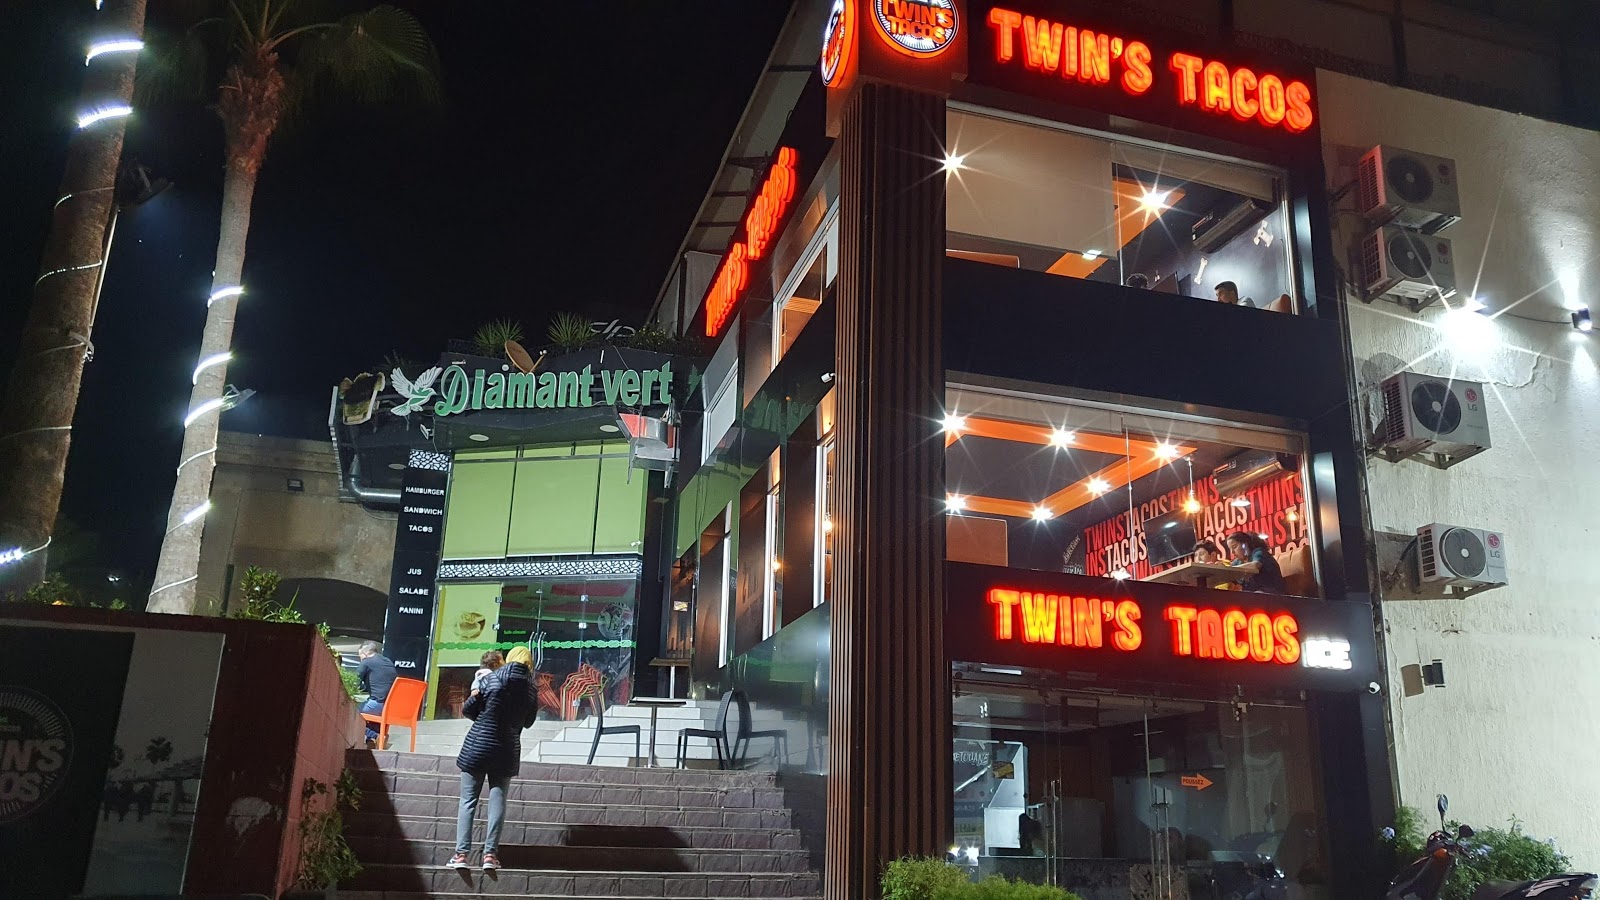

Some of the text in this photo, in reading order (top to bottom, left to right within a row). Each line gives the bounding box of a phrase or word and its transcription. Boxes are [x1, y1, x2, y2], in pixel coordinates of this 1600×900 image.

[886, 15, 946, 45] TACOS
[987, 7, 1314, 133] TWIN'S TACOS
[434, 360, 674, 416] Diamant vert
[1467, 404, 1478, 412] LG
[405, 486, 445, 496] HAMBURGER
[403, 506, 443, 516] SANDWICH
[408, 524, 433, 533] TACOS
[1489, 550, 1501, 559] LG
[407, 568, 422, 576] JUS
[399, 606, 424, 615] PANINI
[989, 588, 1142, 651] TWIN'S
[1167, 606, 1301, 665] TACOS
[394, 660, 416, 669] PIZZA
